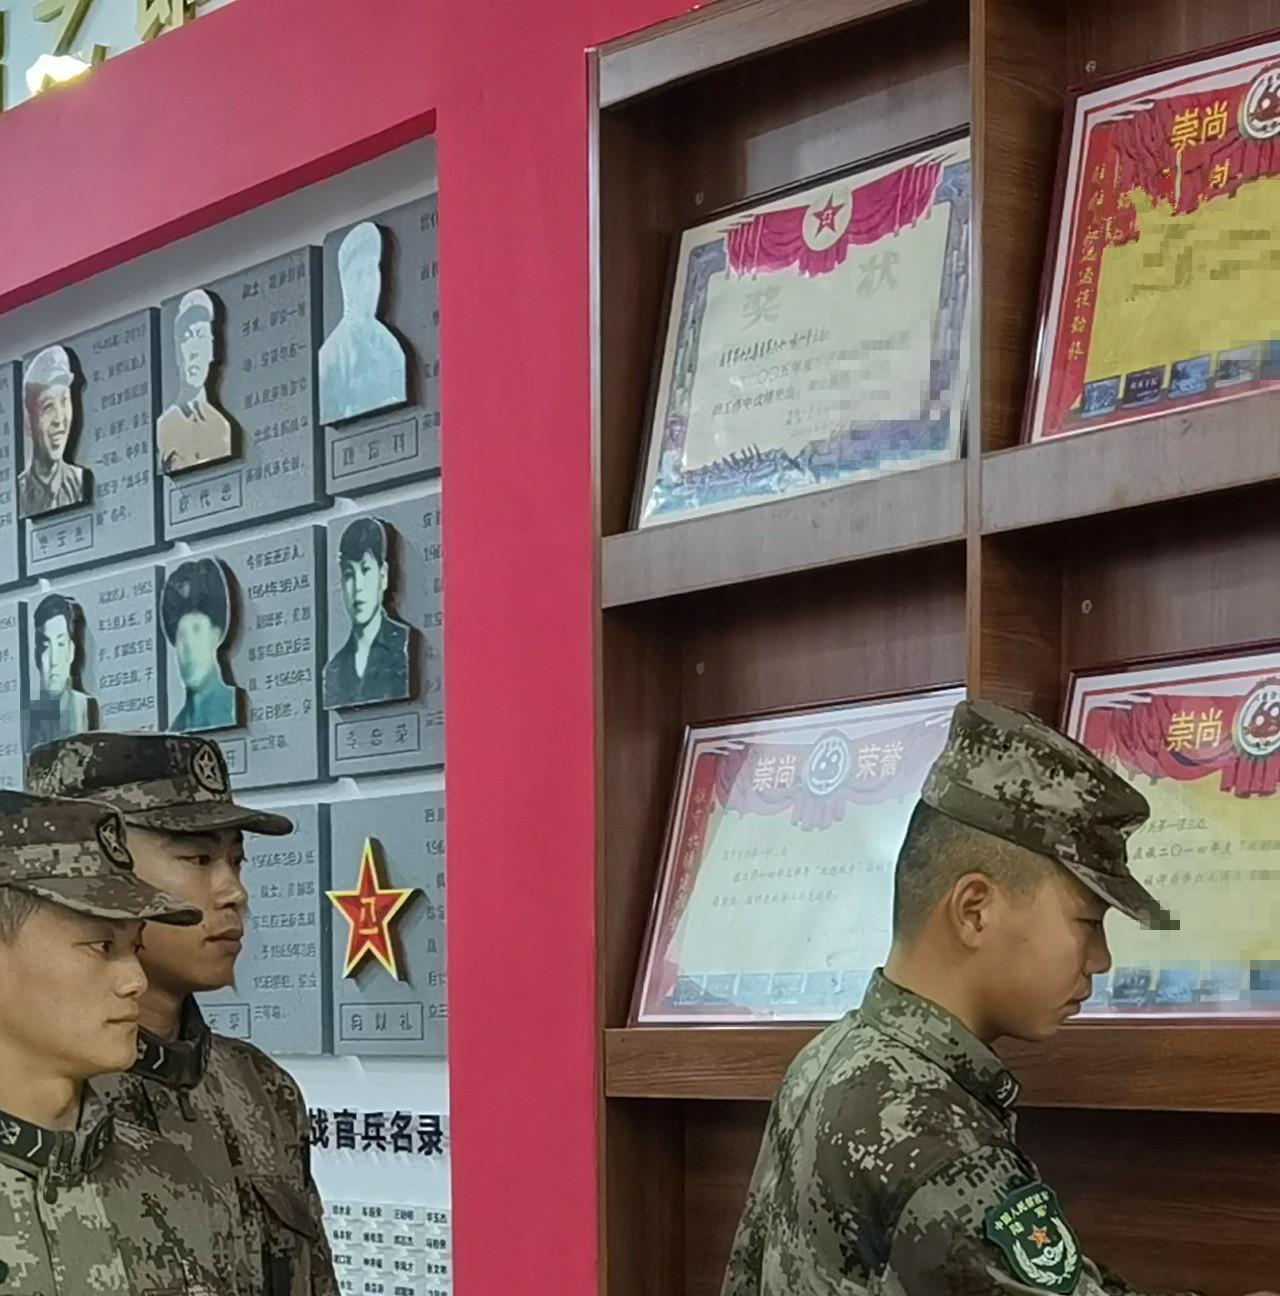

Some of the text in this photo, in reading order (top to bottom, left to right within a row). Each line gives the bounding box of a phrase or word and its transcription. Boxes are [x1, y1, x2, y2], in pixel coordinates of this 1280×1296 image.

[1169, 100, 1228, 154] 崇尚
[1166, 708, 1225, 753] 崇尚
[751, 740, 905, 793] 崇尚 荣誉
